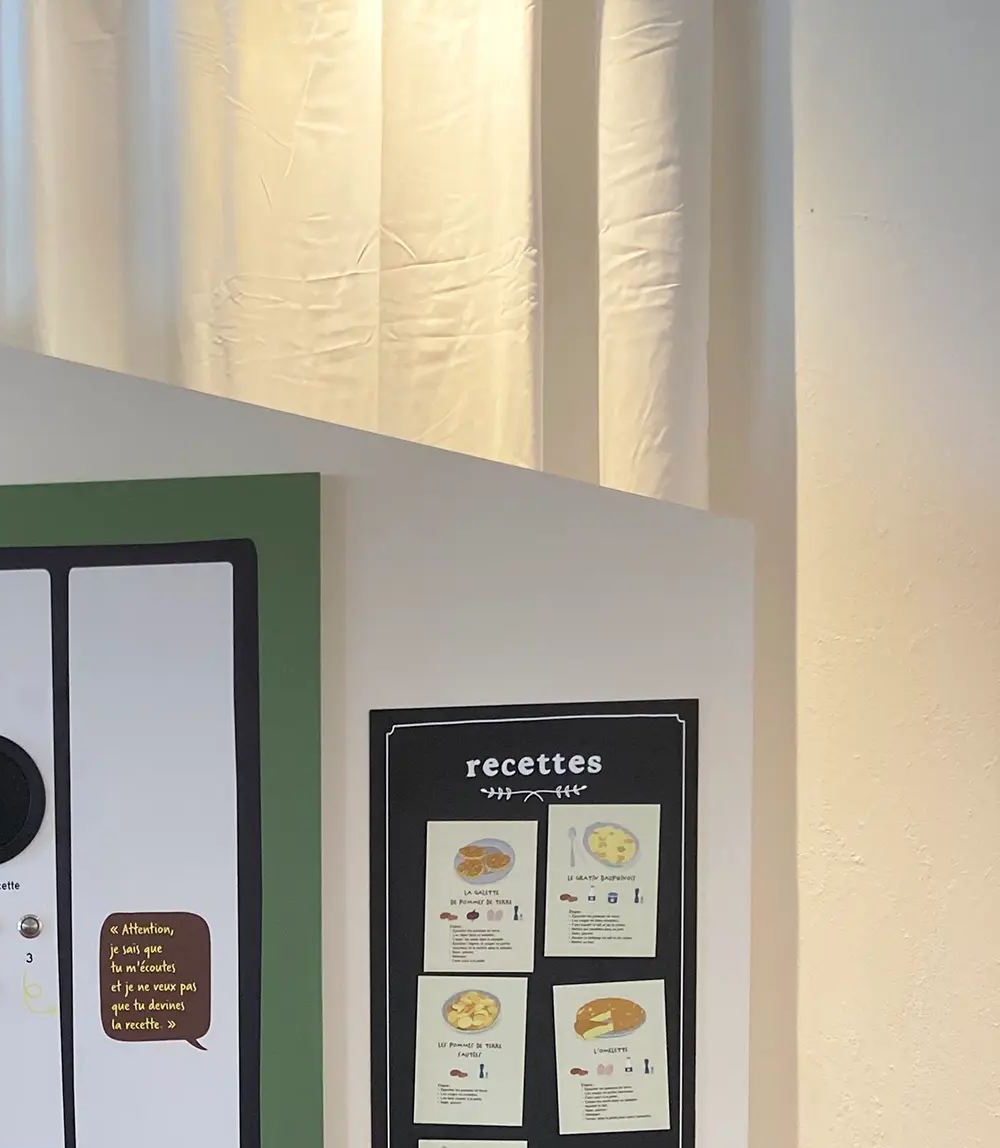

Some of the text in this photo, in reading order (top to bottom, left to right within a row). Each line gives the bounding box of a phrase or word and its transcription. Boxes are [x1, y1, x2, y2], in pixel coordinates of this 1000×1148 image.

[466, 753, 602, 778] recettes
[121, 921, 175, 936] Attention,
[26, 952, 34, 964] 3
[109, 942, 163, 960] je sais que
[110, 960, 176, 973] tu m'écoutes
[111, 980, 197, 998] et je ne veux pas
[111, 998, 185, 1016] que tu devines
[111, 1018, 122, 1030] la
